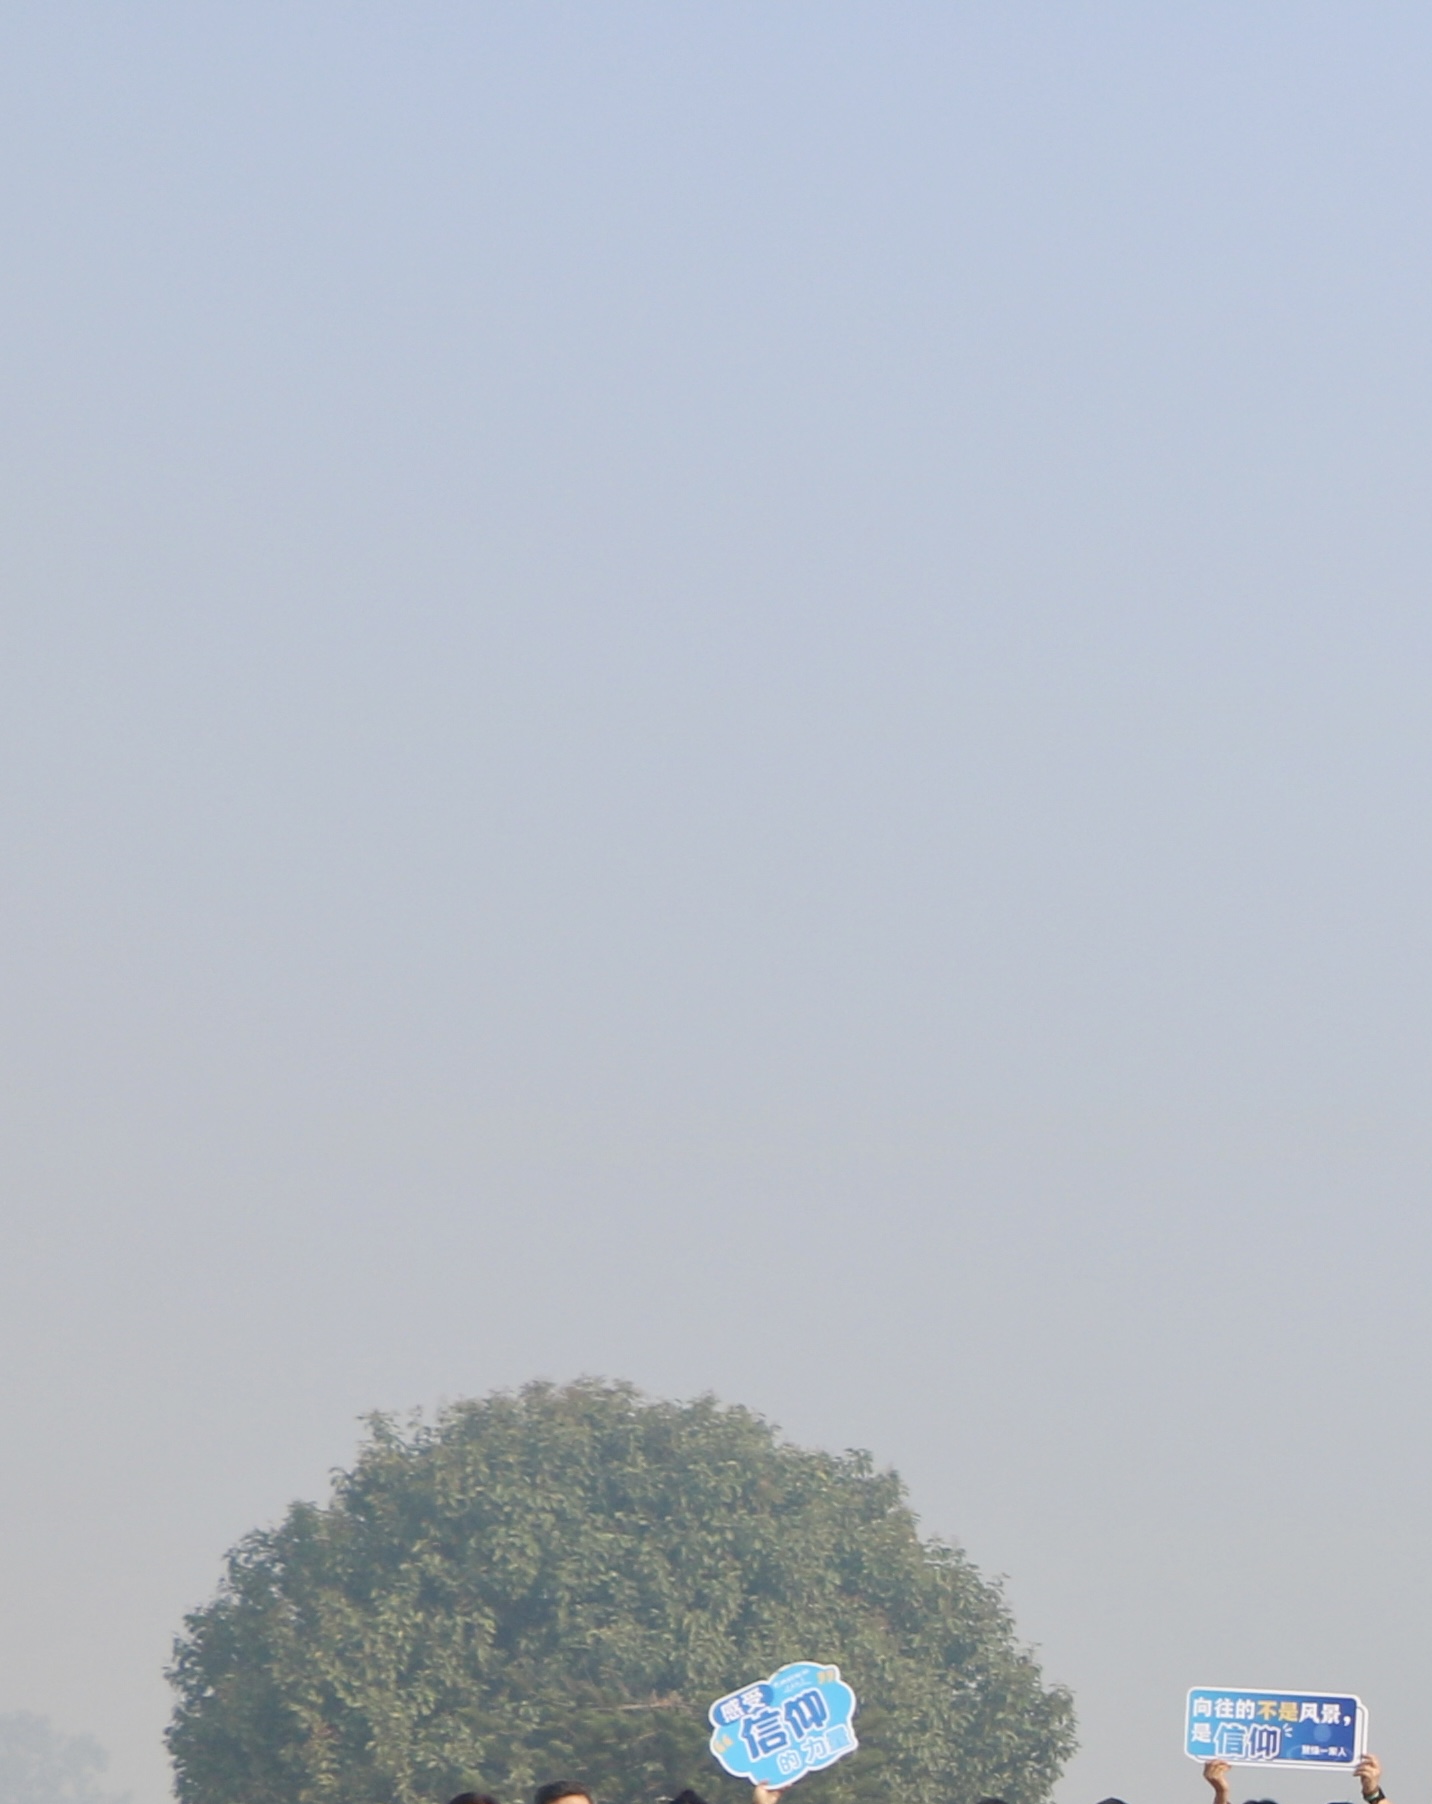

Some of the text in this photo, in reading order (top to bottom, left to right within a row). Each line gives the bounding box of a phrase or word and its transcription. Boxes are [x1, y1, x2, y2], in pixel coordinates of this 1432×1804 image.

[741, 1690, 828, 1760] 信仰
[1191, 1721, 1282, 1760] 是信仰
